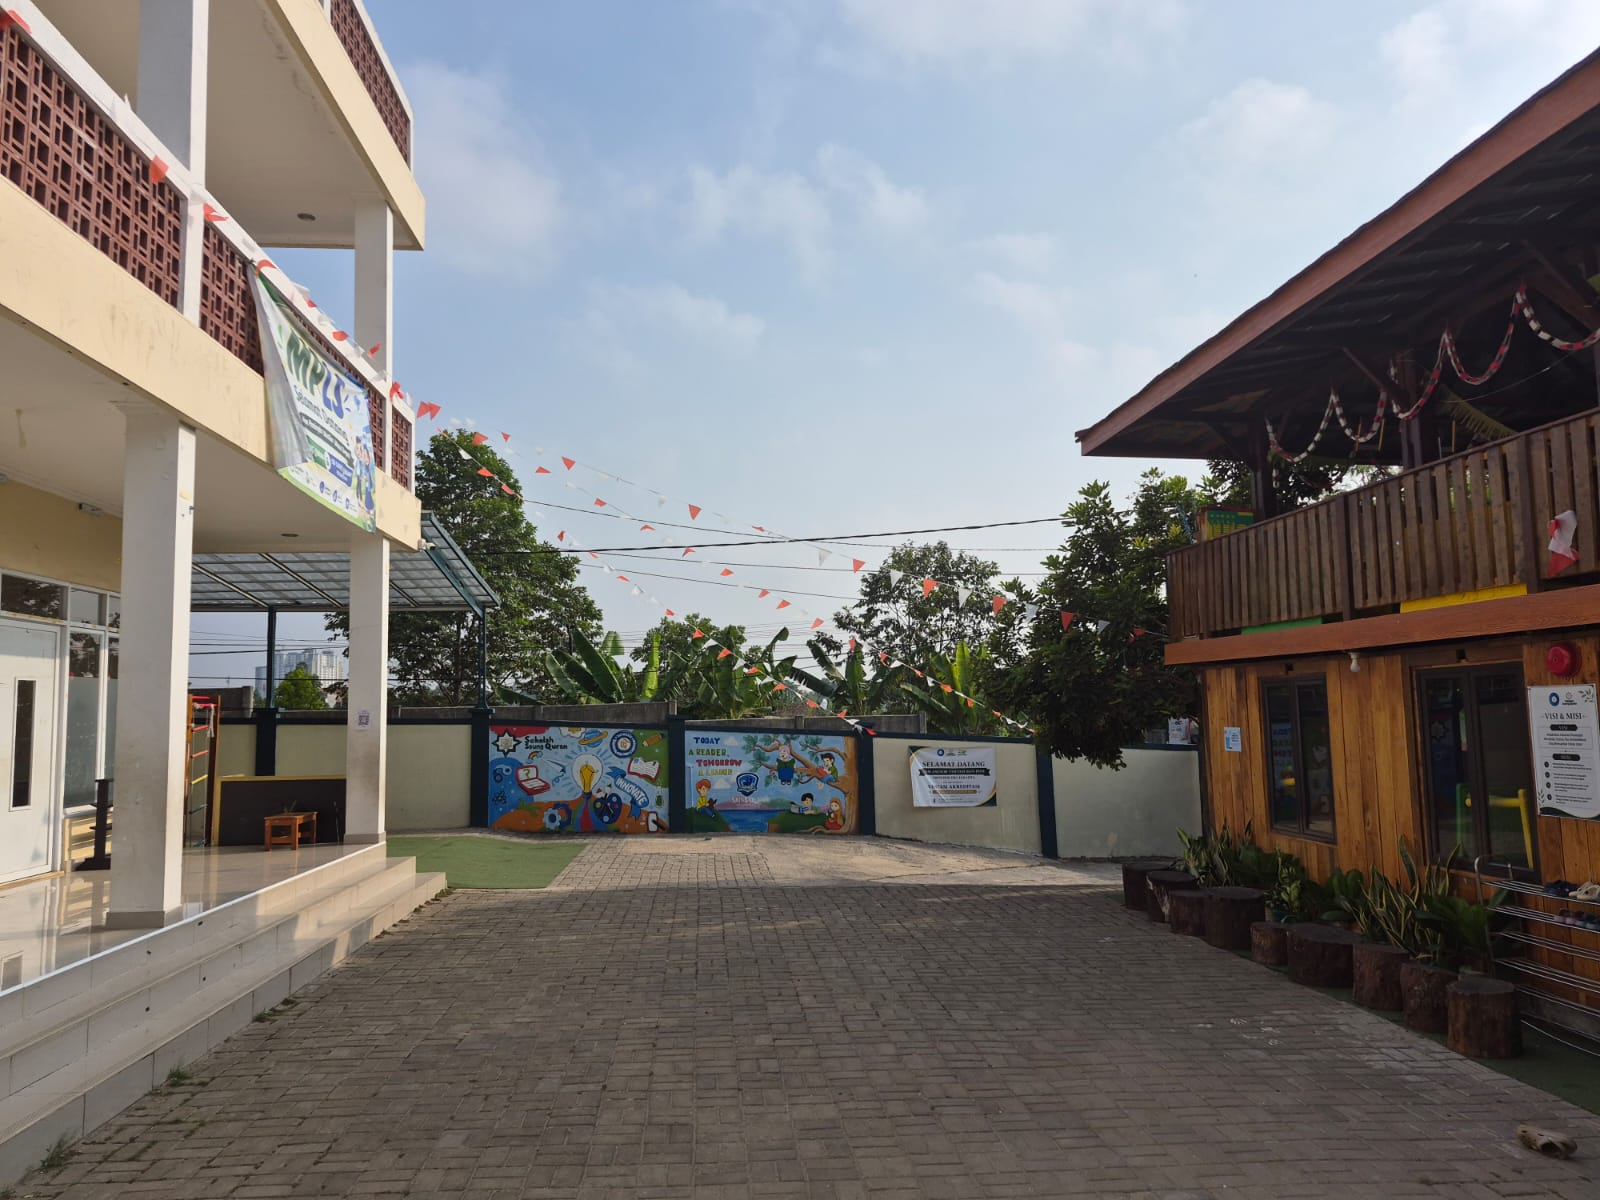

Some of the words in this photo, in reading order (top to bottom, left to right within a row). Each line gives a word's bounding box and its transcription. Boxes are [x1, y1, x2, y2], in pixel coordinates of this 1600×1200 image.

[286, 332, 346, 420] MPLS
[1544, 712, 1559, 720] VISI
[1566, 712, 1582, 720] MISI
[693, 736, 721, 745] TODAY
[696, 758, 743, 767] TOMORROW
[615, 776, 648, 805] INNOVATE
